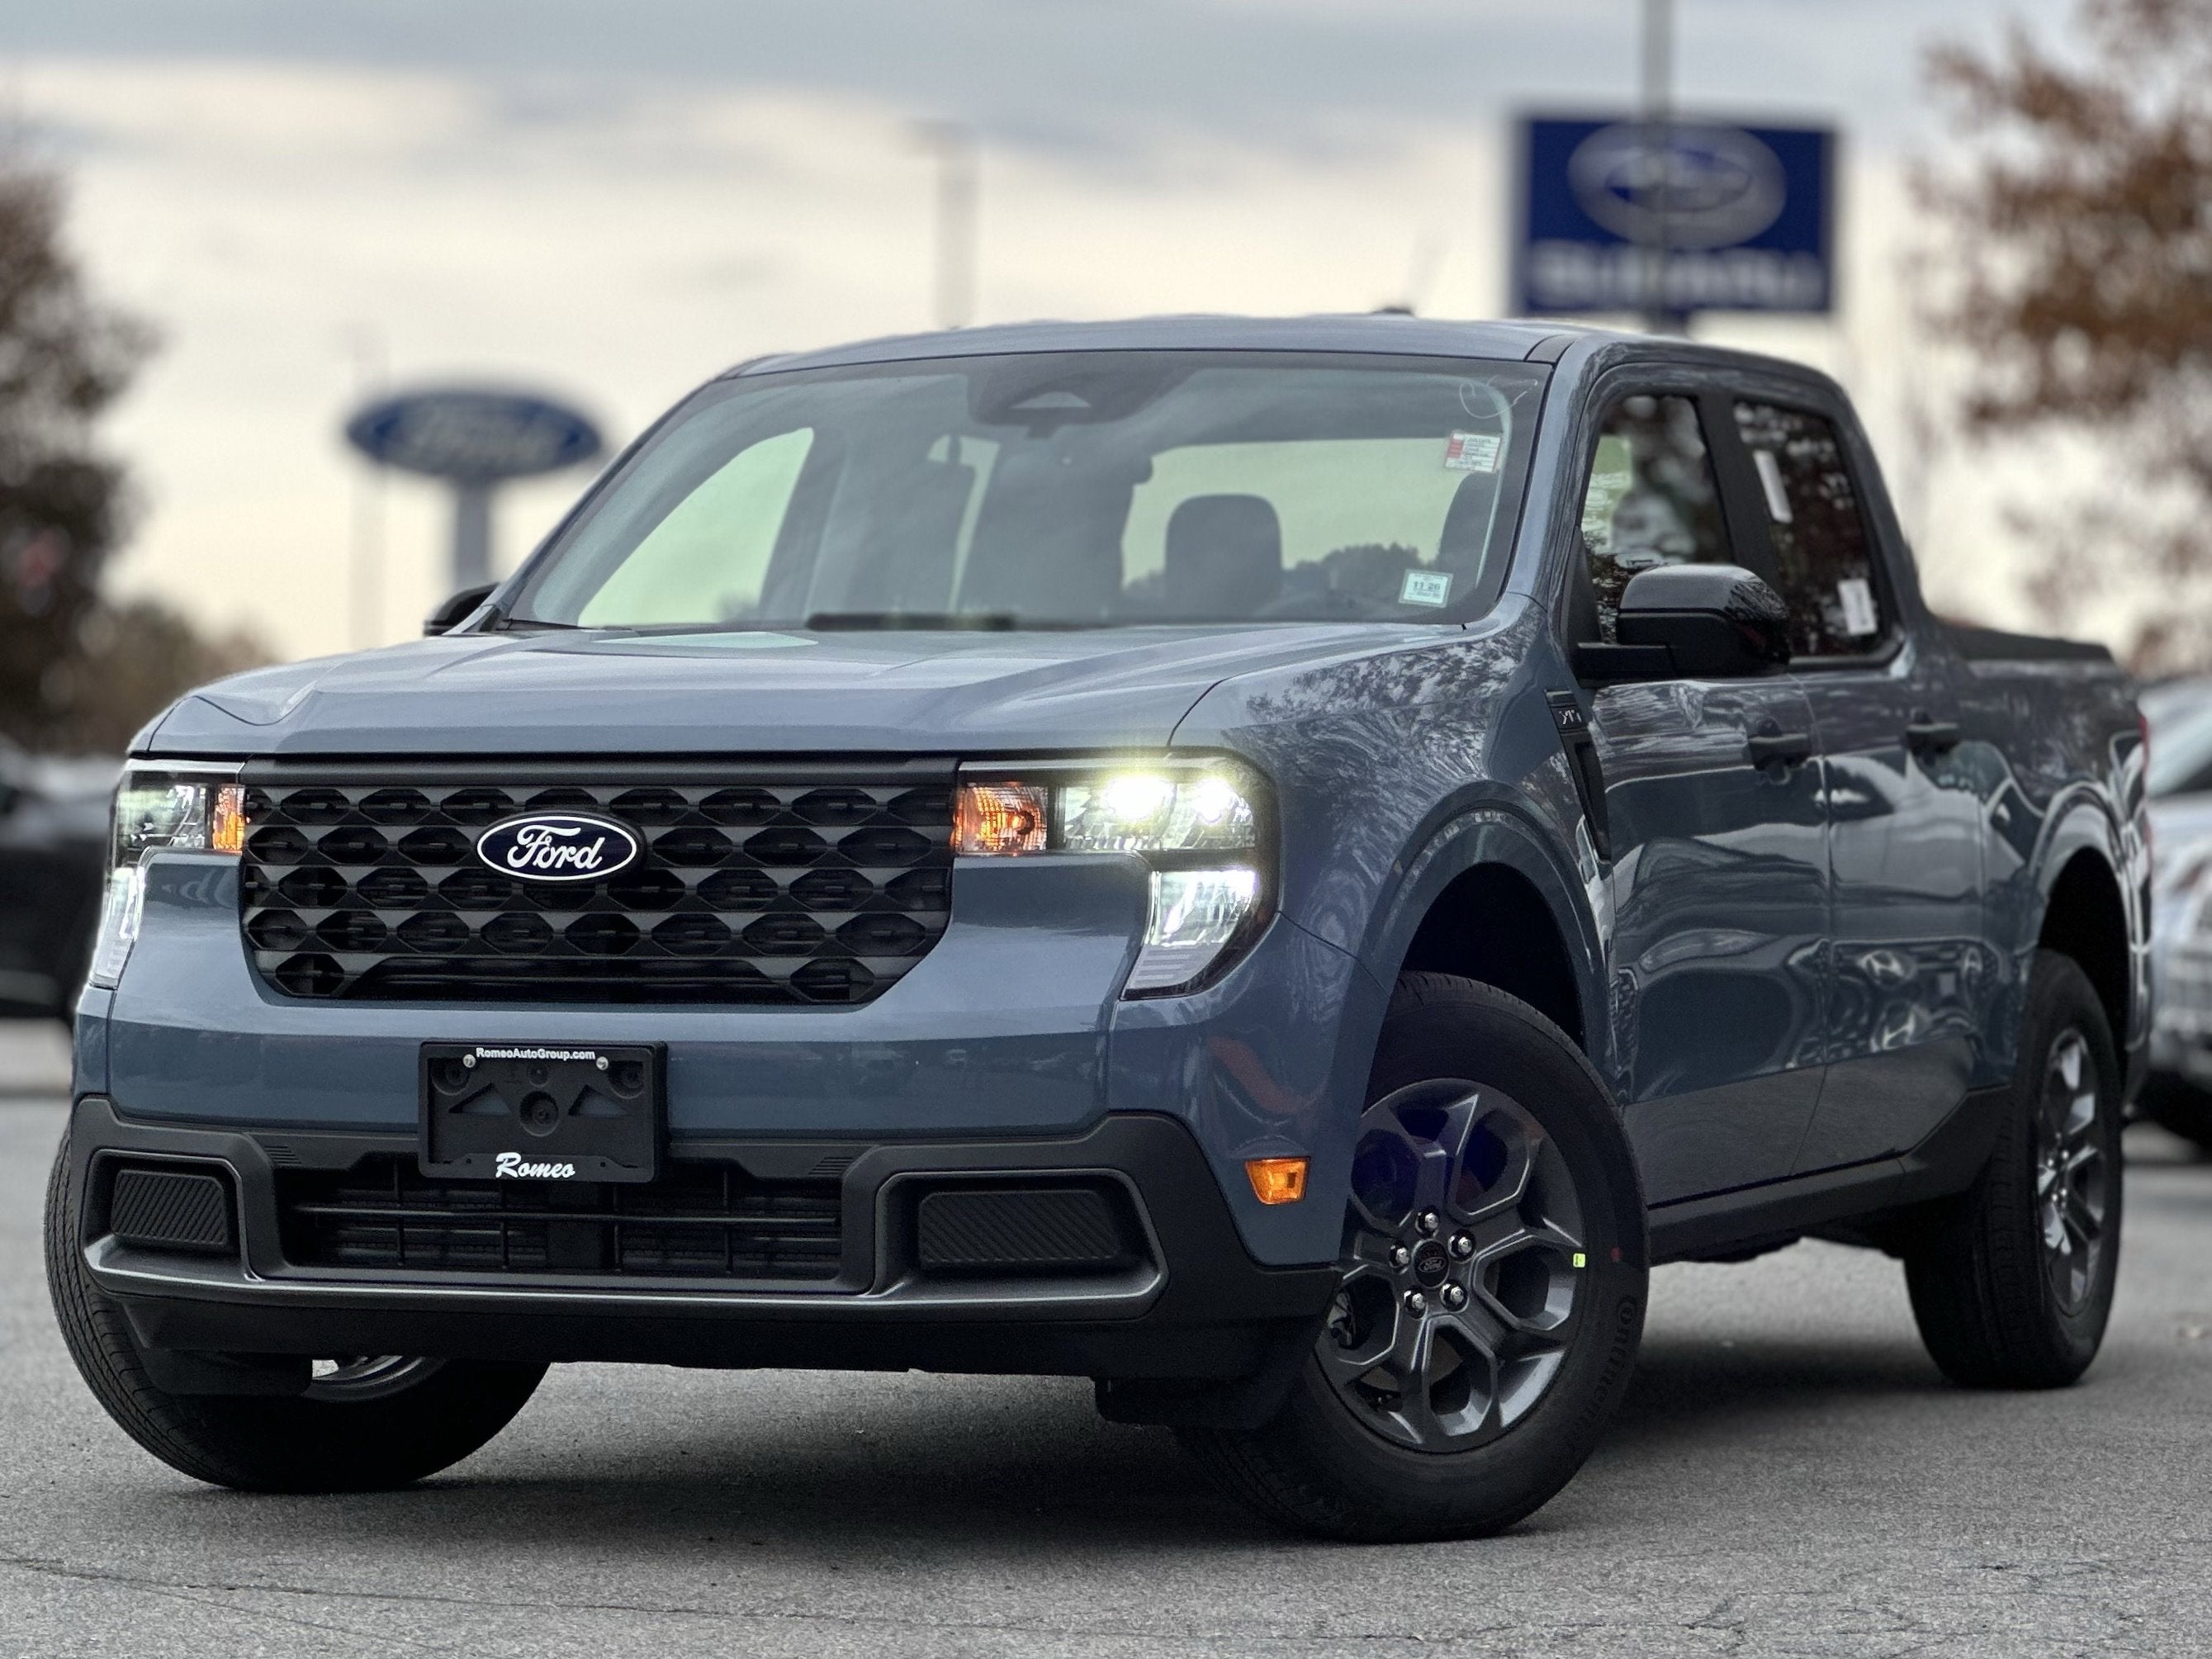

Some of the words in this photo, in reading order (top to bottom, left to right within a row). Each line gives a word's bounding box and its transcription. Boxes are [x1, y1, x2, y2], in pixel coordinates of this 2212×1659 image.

[507, 824, 606, 870] Ford
[476, 1047, 596, 1061] RomeoAutoGroup.com
[495, 1151, 576, 1178] Romeo
